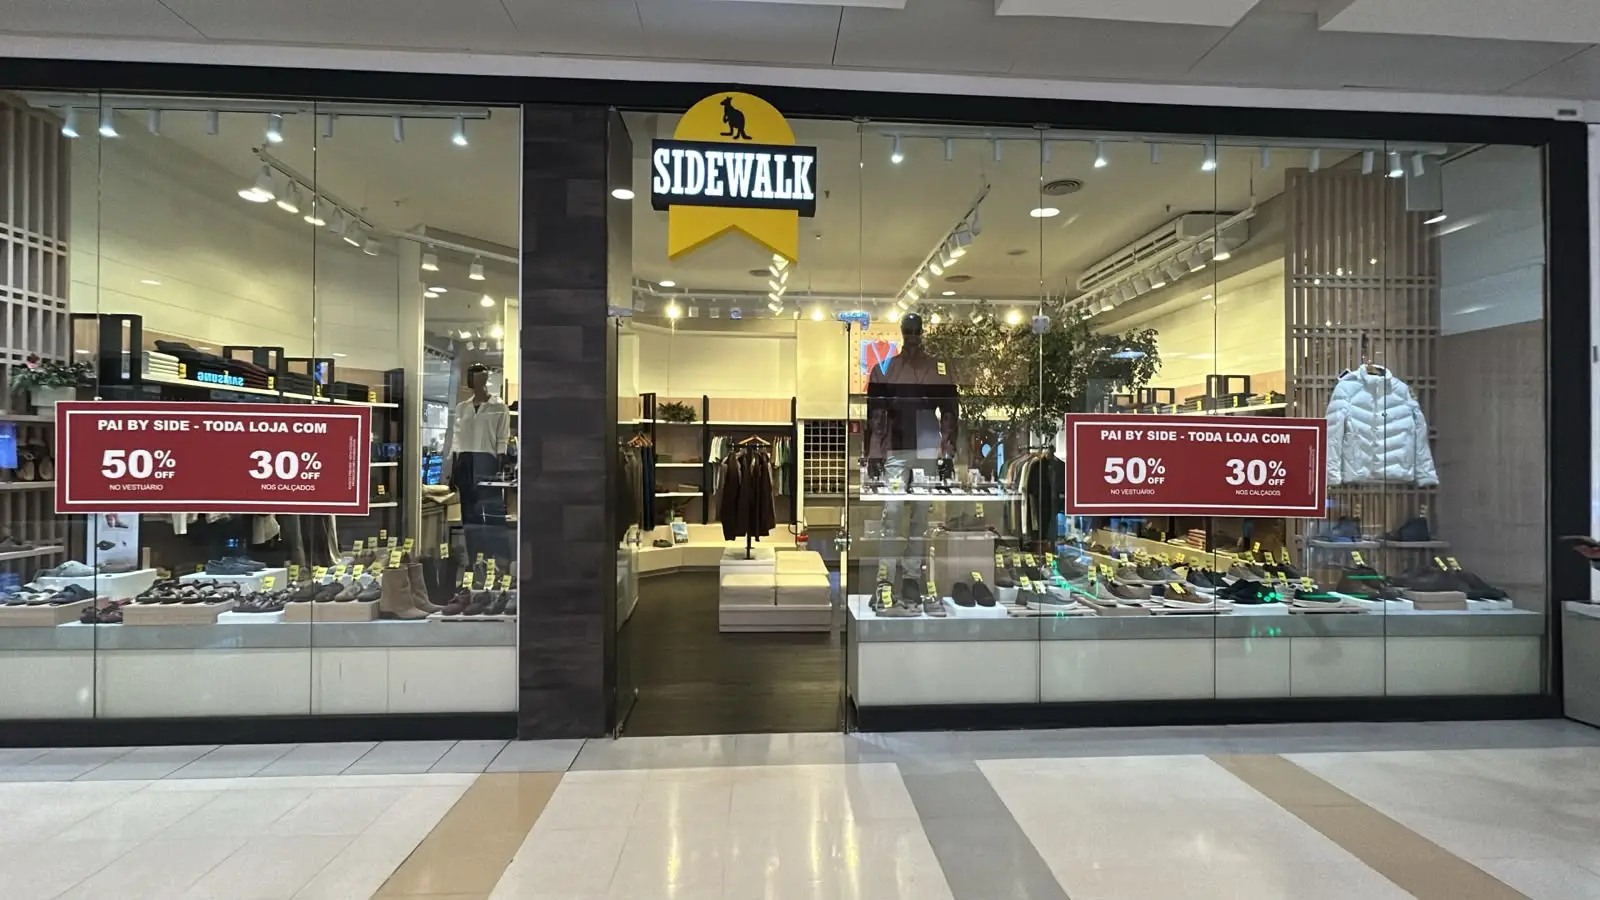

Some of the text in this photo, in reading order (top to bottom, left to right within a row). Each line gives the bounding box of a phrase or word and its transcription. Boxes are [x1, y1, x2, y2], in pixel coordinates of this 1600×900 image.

[653, 148, 814, 200] SIDEWALK
[98, 419, 123, 431] PAI
[127, 420, 149, 431] BY
[153, 420, 190, 431] SIDE
[203, 420, 245, 432] TODA
[249, 421, 289, 433] LOJA
[293, 422, 327, 434] COM
[1100, 430, 1122, 441] PAI
[1125, 430, 1143, 441] BY
[1147, 430, 1177, 441] SIDE
[1188, 431, 1223, 442] TODA
[1226, 432, 1259, 443] LOJA
[1261, 433, 1291, 444] COM
[101, 449, 176, 479] 50%
[248, 450, 322, 480] 30%
[1103, 457, 1166, 484] 50%
[154, 471, 176, 479] OFF
[300, 472, 321, 480] OFF
[1225, 458, 1287, 486] 30%
[122, 483, 164, 491] VESTUÁRIO
[277, 484, 316, 492] CALÇADOS
[1147, 477, 1165, 485] OFF
